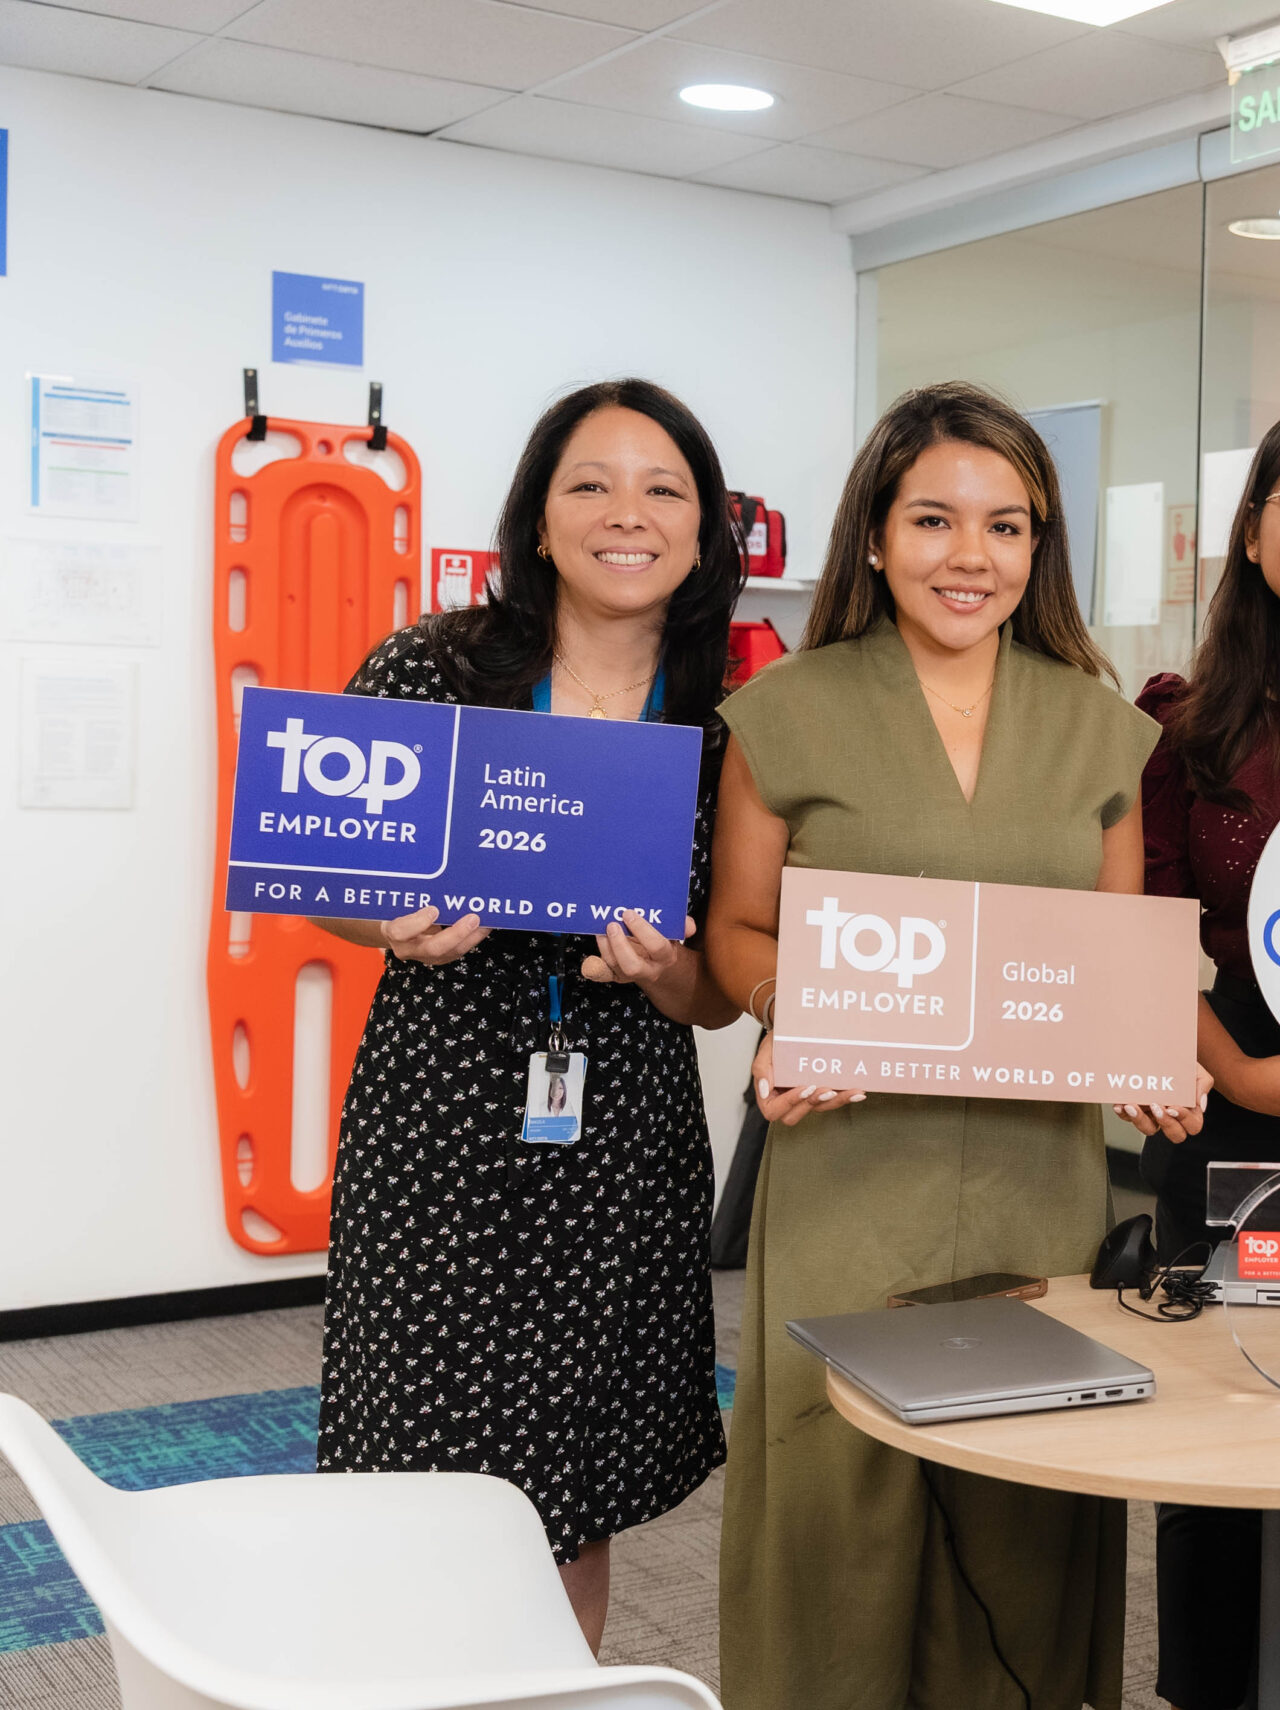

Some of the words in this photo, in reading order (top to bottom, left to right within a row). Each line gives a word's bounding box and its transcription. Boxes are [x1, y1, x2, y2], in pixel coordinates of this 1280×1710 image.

[284, 311, 328, 326] Gabinete
[284, 324, 297, 335] de
[299, 325, 343, 340] Primeros
[284, 337, 323, 351] Auxilios
[266, 717, 421, 815] top
[484, 763, 546, 788] Latin
[480, 789, 584, 816] America
[259, 811, 416, 843] EMPLOYER
[478, 828, 547, 852] 2026
[254, 882, 302, 900] FOR
[315, 886, 330, 902] A
[344, 888, 431, 908] BETTER
[444, 894, 533, 915] WORLD
[547, 902, 577, 918] OF
[806, 897, 946, 988] top
[1002, 962, 1075, 985] Global
[801, 987, 944, 1016] EMPLOYER
[1001, 1000, 1064, 1023] 2026
[799, 1057, 842, 1074] FOR
[854, 1060, 868, 1076] A
[880, 1061, 960, 1081] BETTER
[972, 1066, 1055, 1085] WORLD
[1067, 1071, 1095, 1087] OF
[1107, 1073, 1174, 1091] WORK
